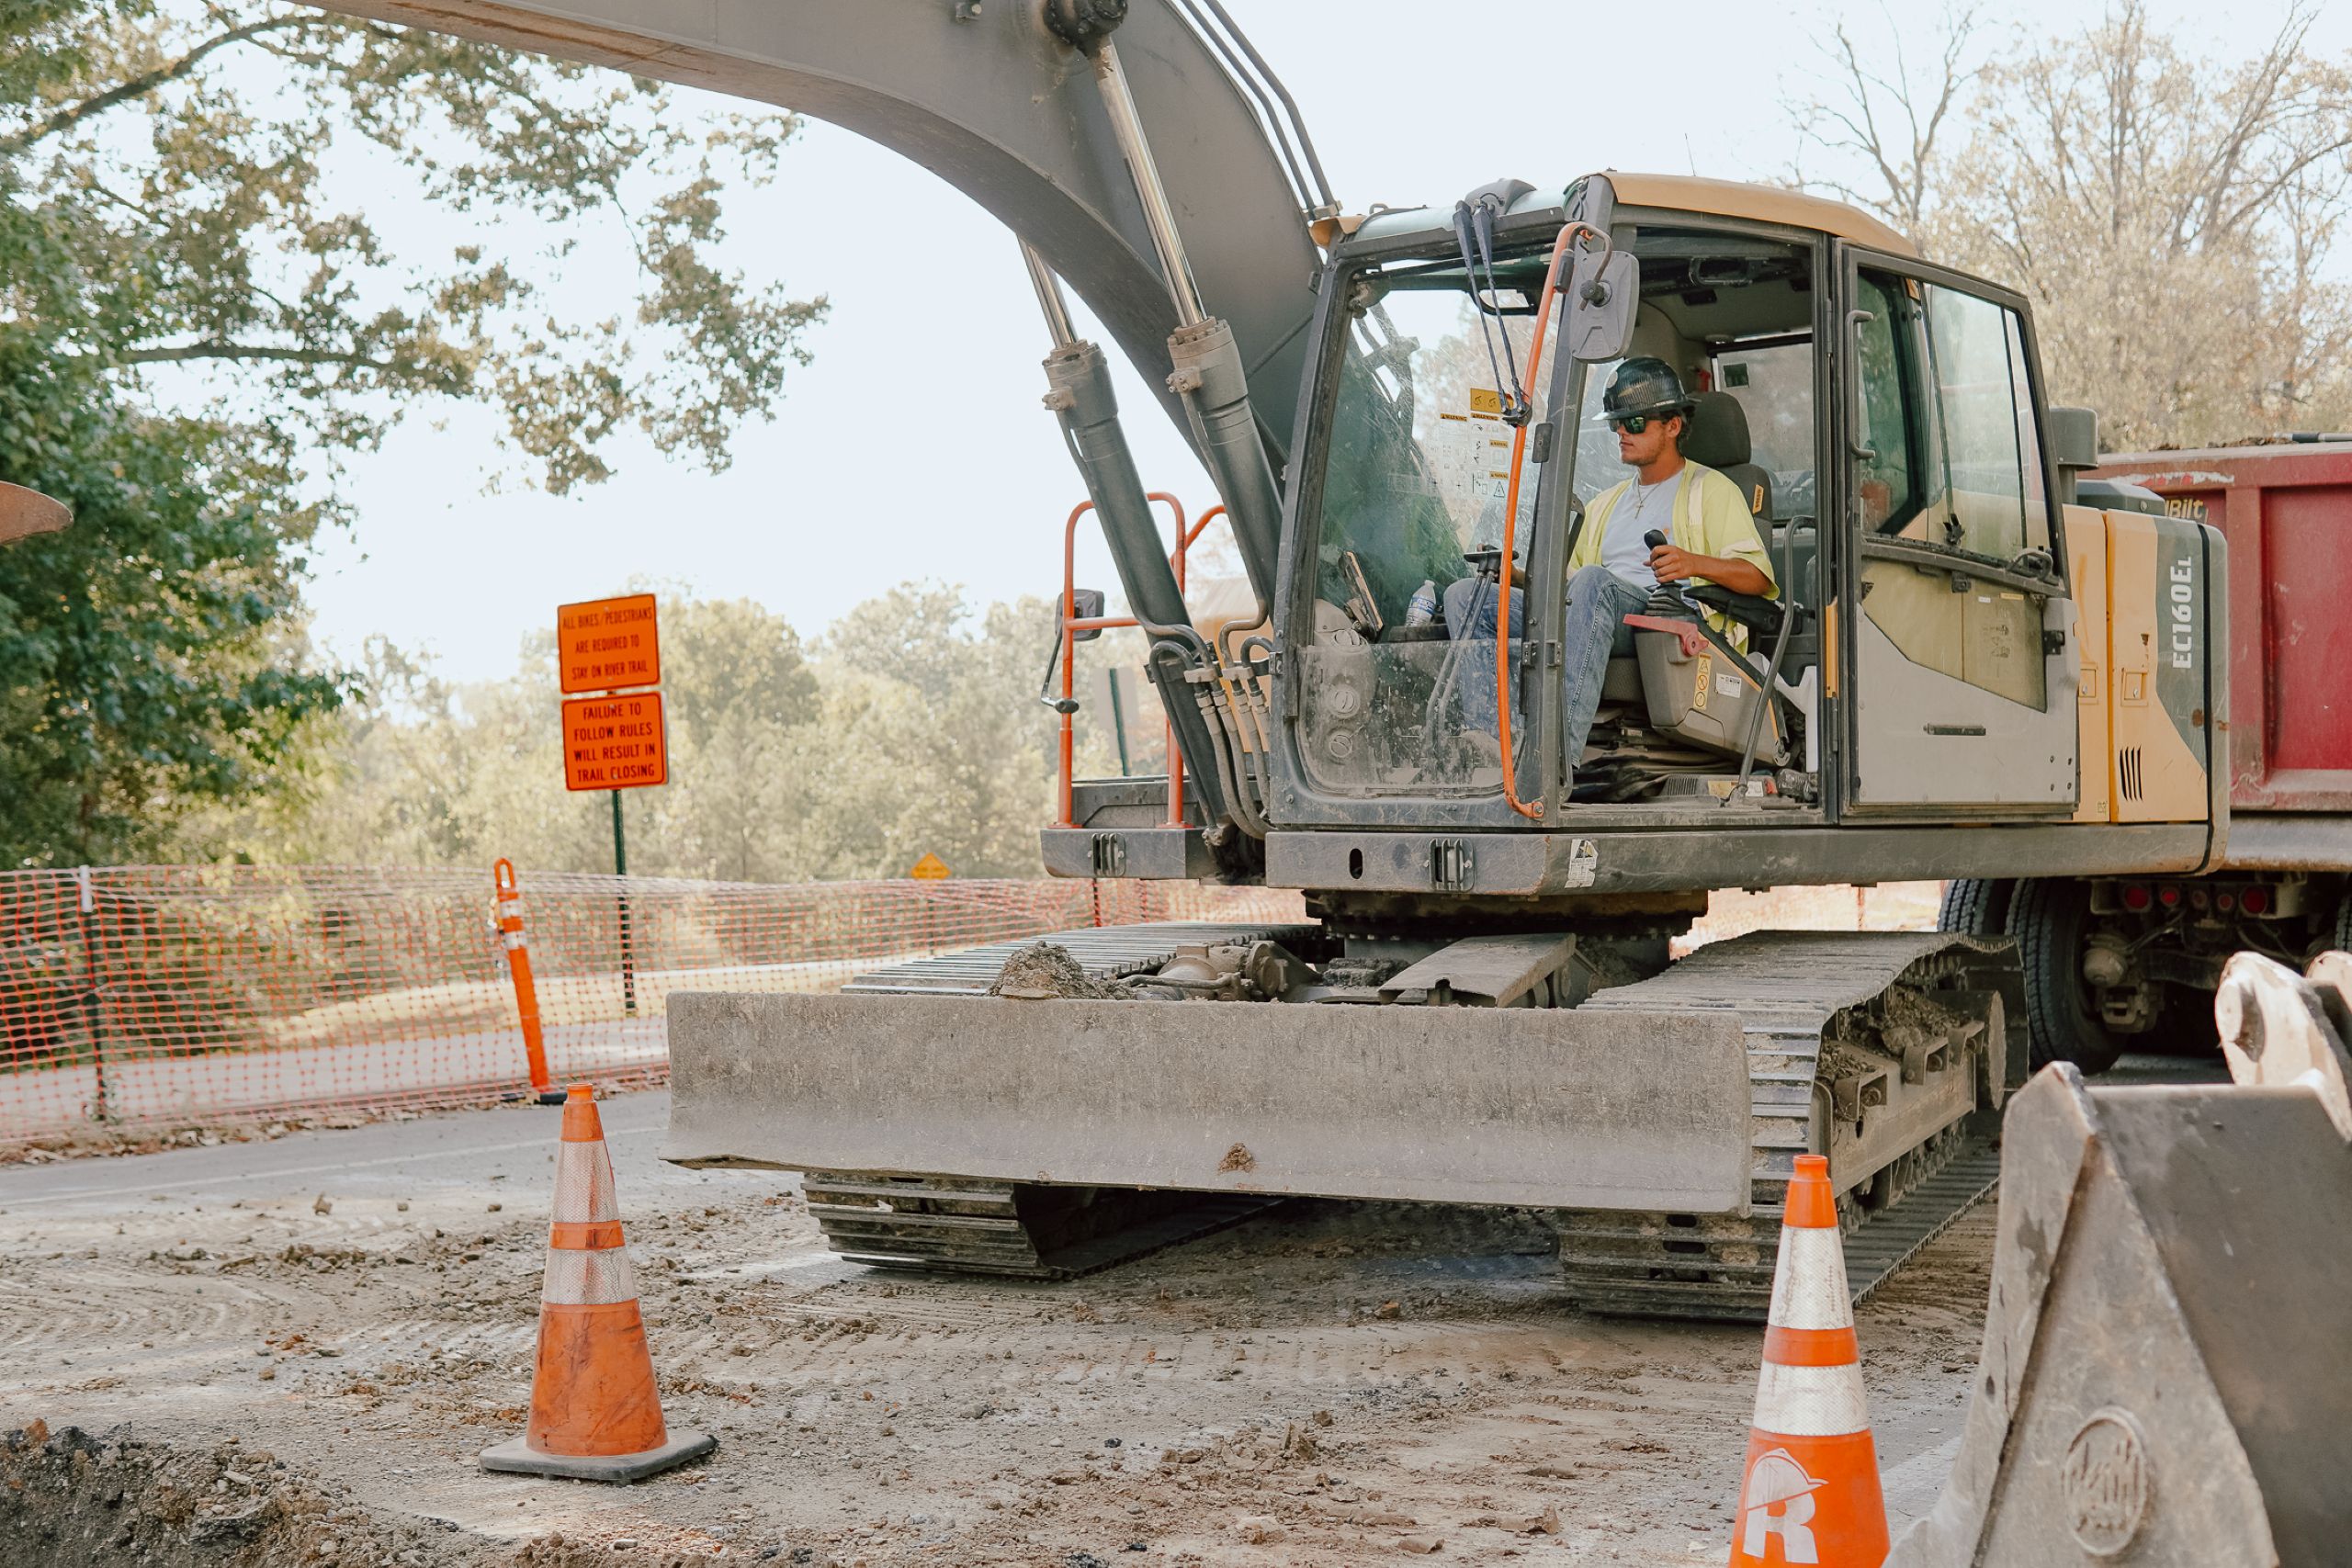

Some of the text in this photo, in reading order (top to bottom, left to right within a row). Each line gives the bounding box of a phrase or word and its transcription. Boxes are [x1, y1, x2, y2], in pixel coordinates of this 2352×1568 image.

[563, 616, 575, 629] ALL
[576, 634, 640, 653] ARE REQUIRED TO
[571, 660, 648, 680] STAY ON RIVER TRAIL
[583, 702, 641, 720] FAILURE TO
[574, 722, 653, 741] FOLLOW RULES
[573, 742, 655, 761] WILL RESULT IN
[577, 763, 654, 782] TRAIL CLOSING
